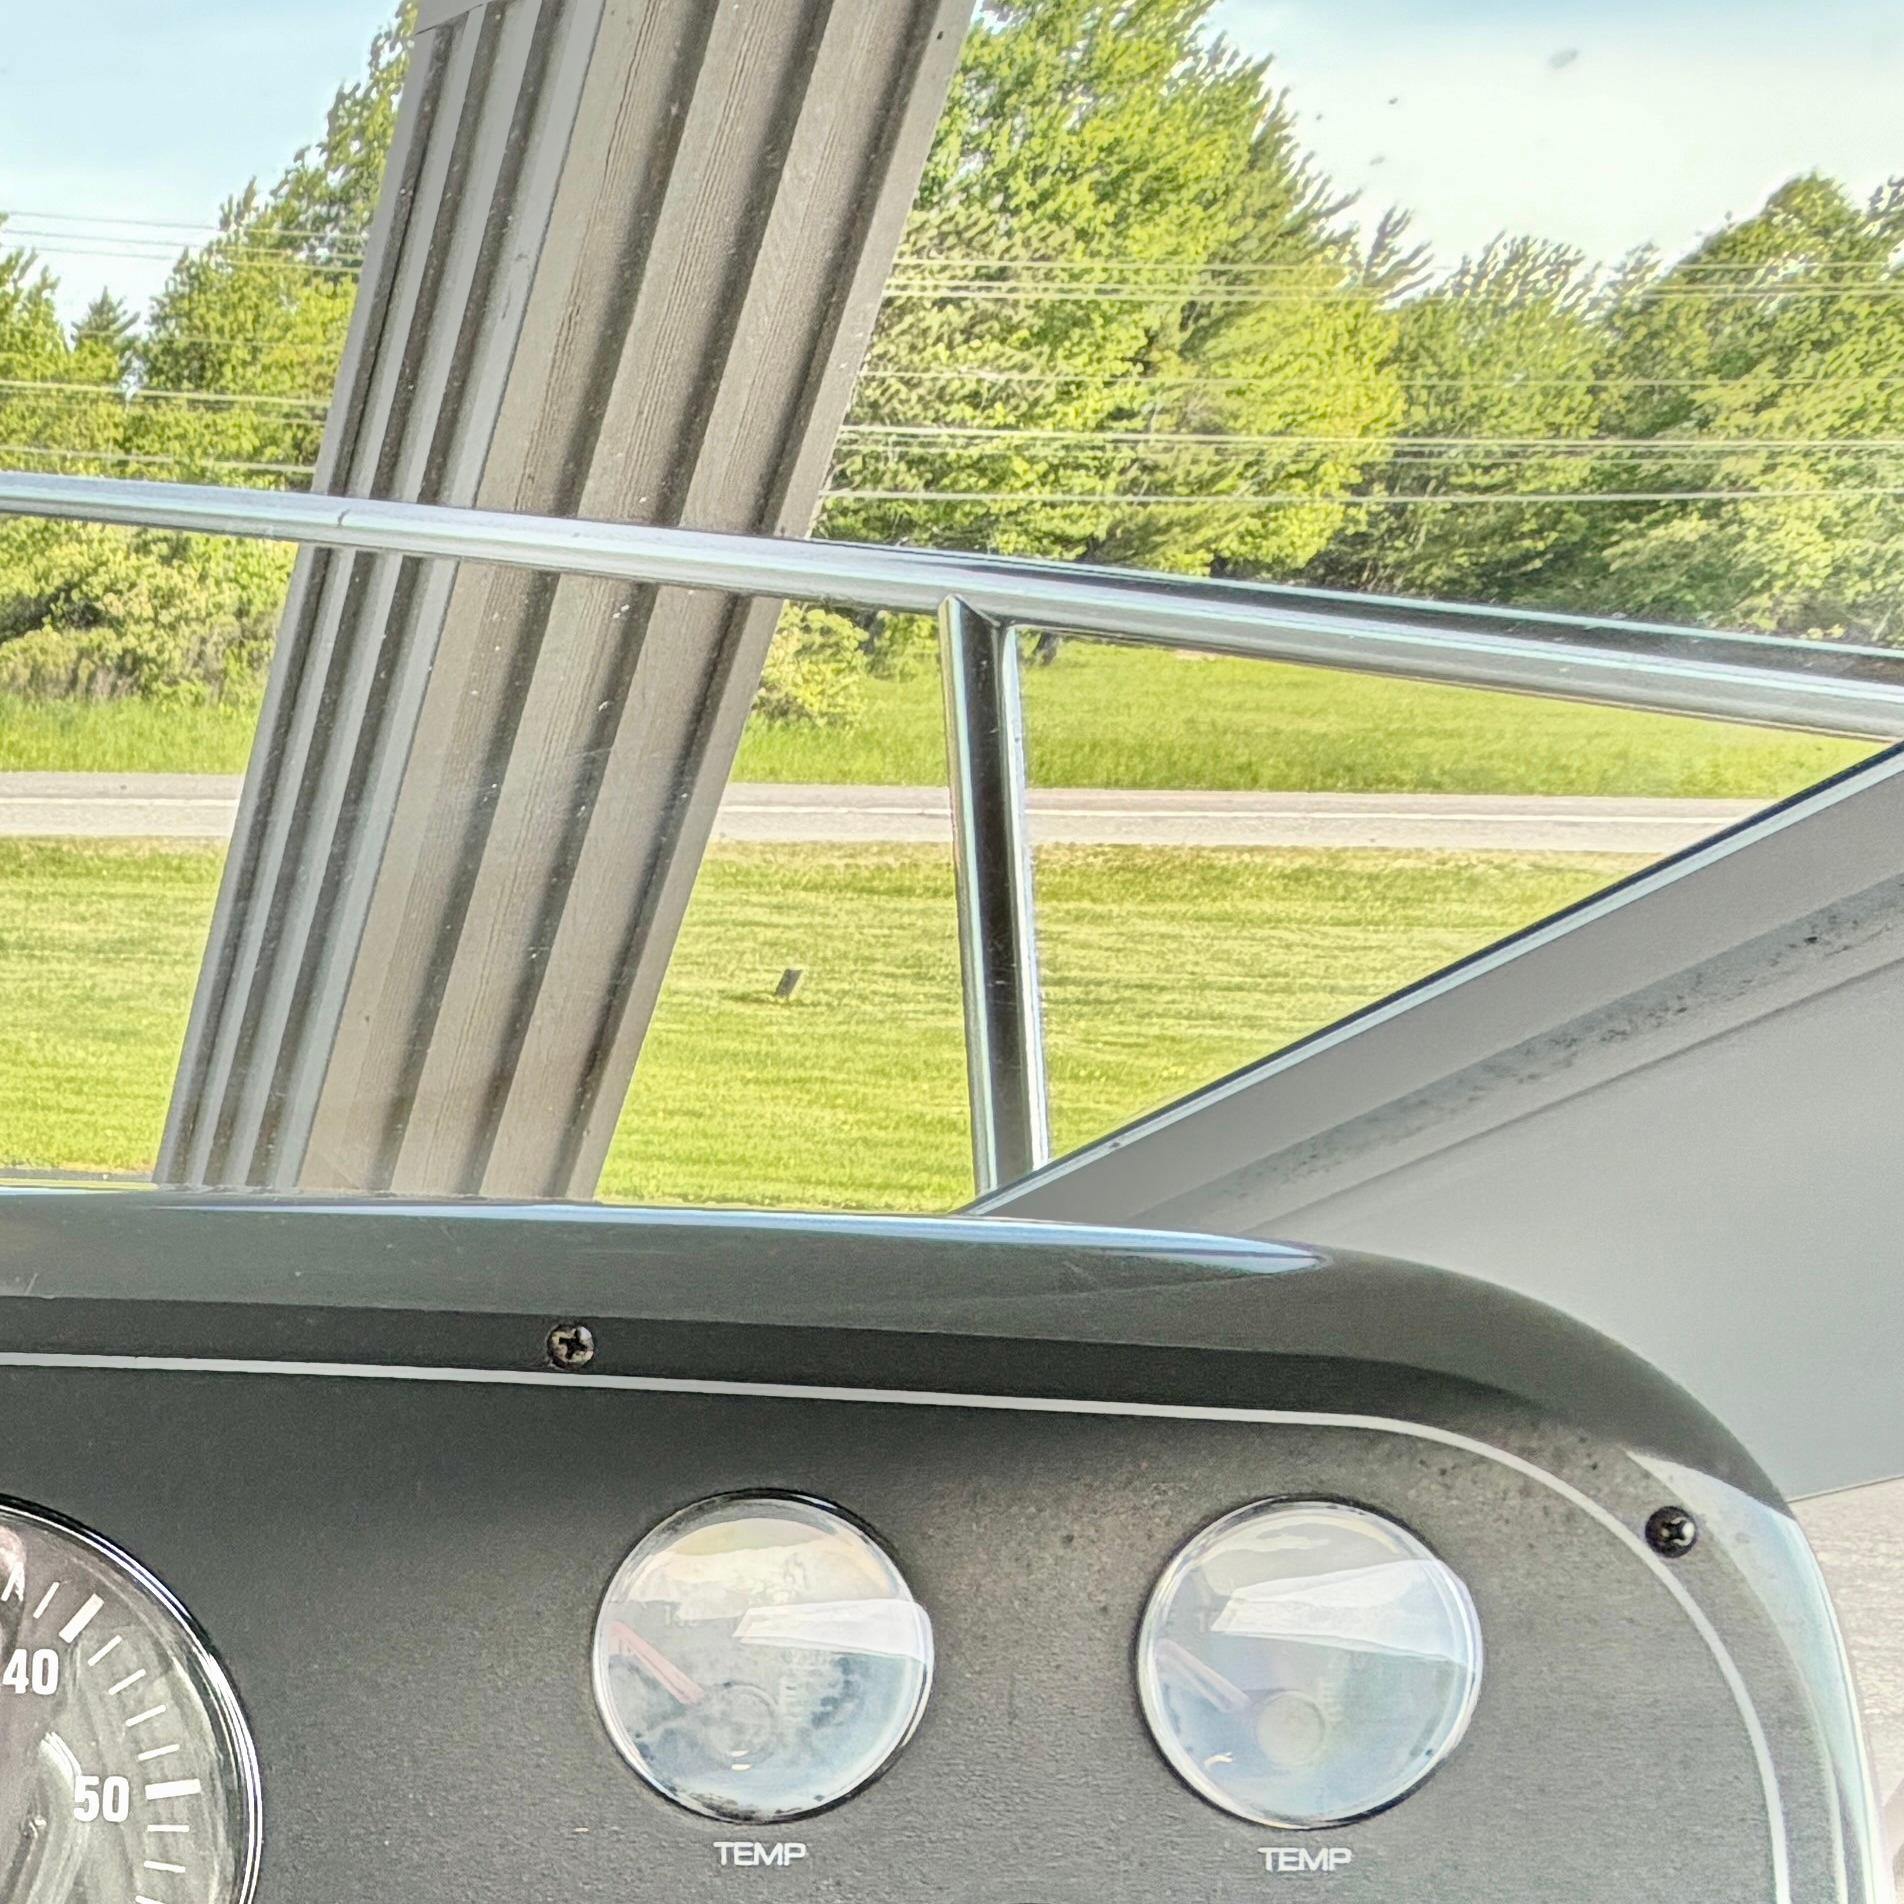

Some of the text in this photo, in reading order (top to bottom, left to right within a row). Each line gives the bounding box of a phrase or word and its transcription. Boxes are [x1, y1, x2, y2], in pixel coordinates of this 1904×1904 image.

[3, 1649, 59, 1695] 40
[73, 1776, 129, 1822] 50
[713, 1841, 807, 1866] TEMP
[1258, 1847, 1353, 1872] TEMP
